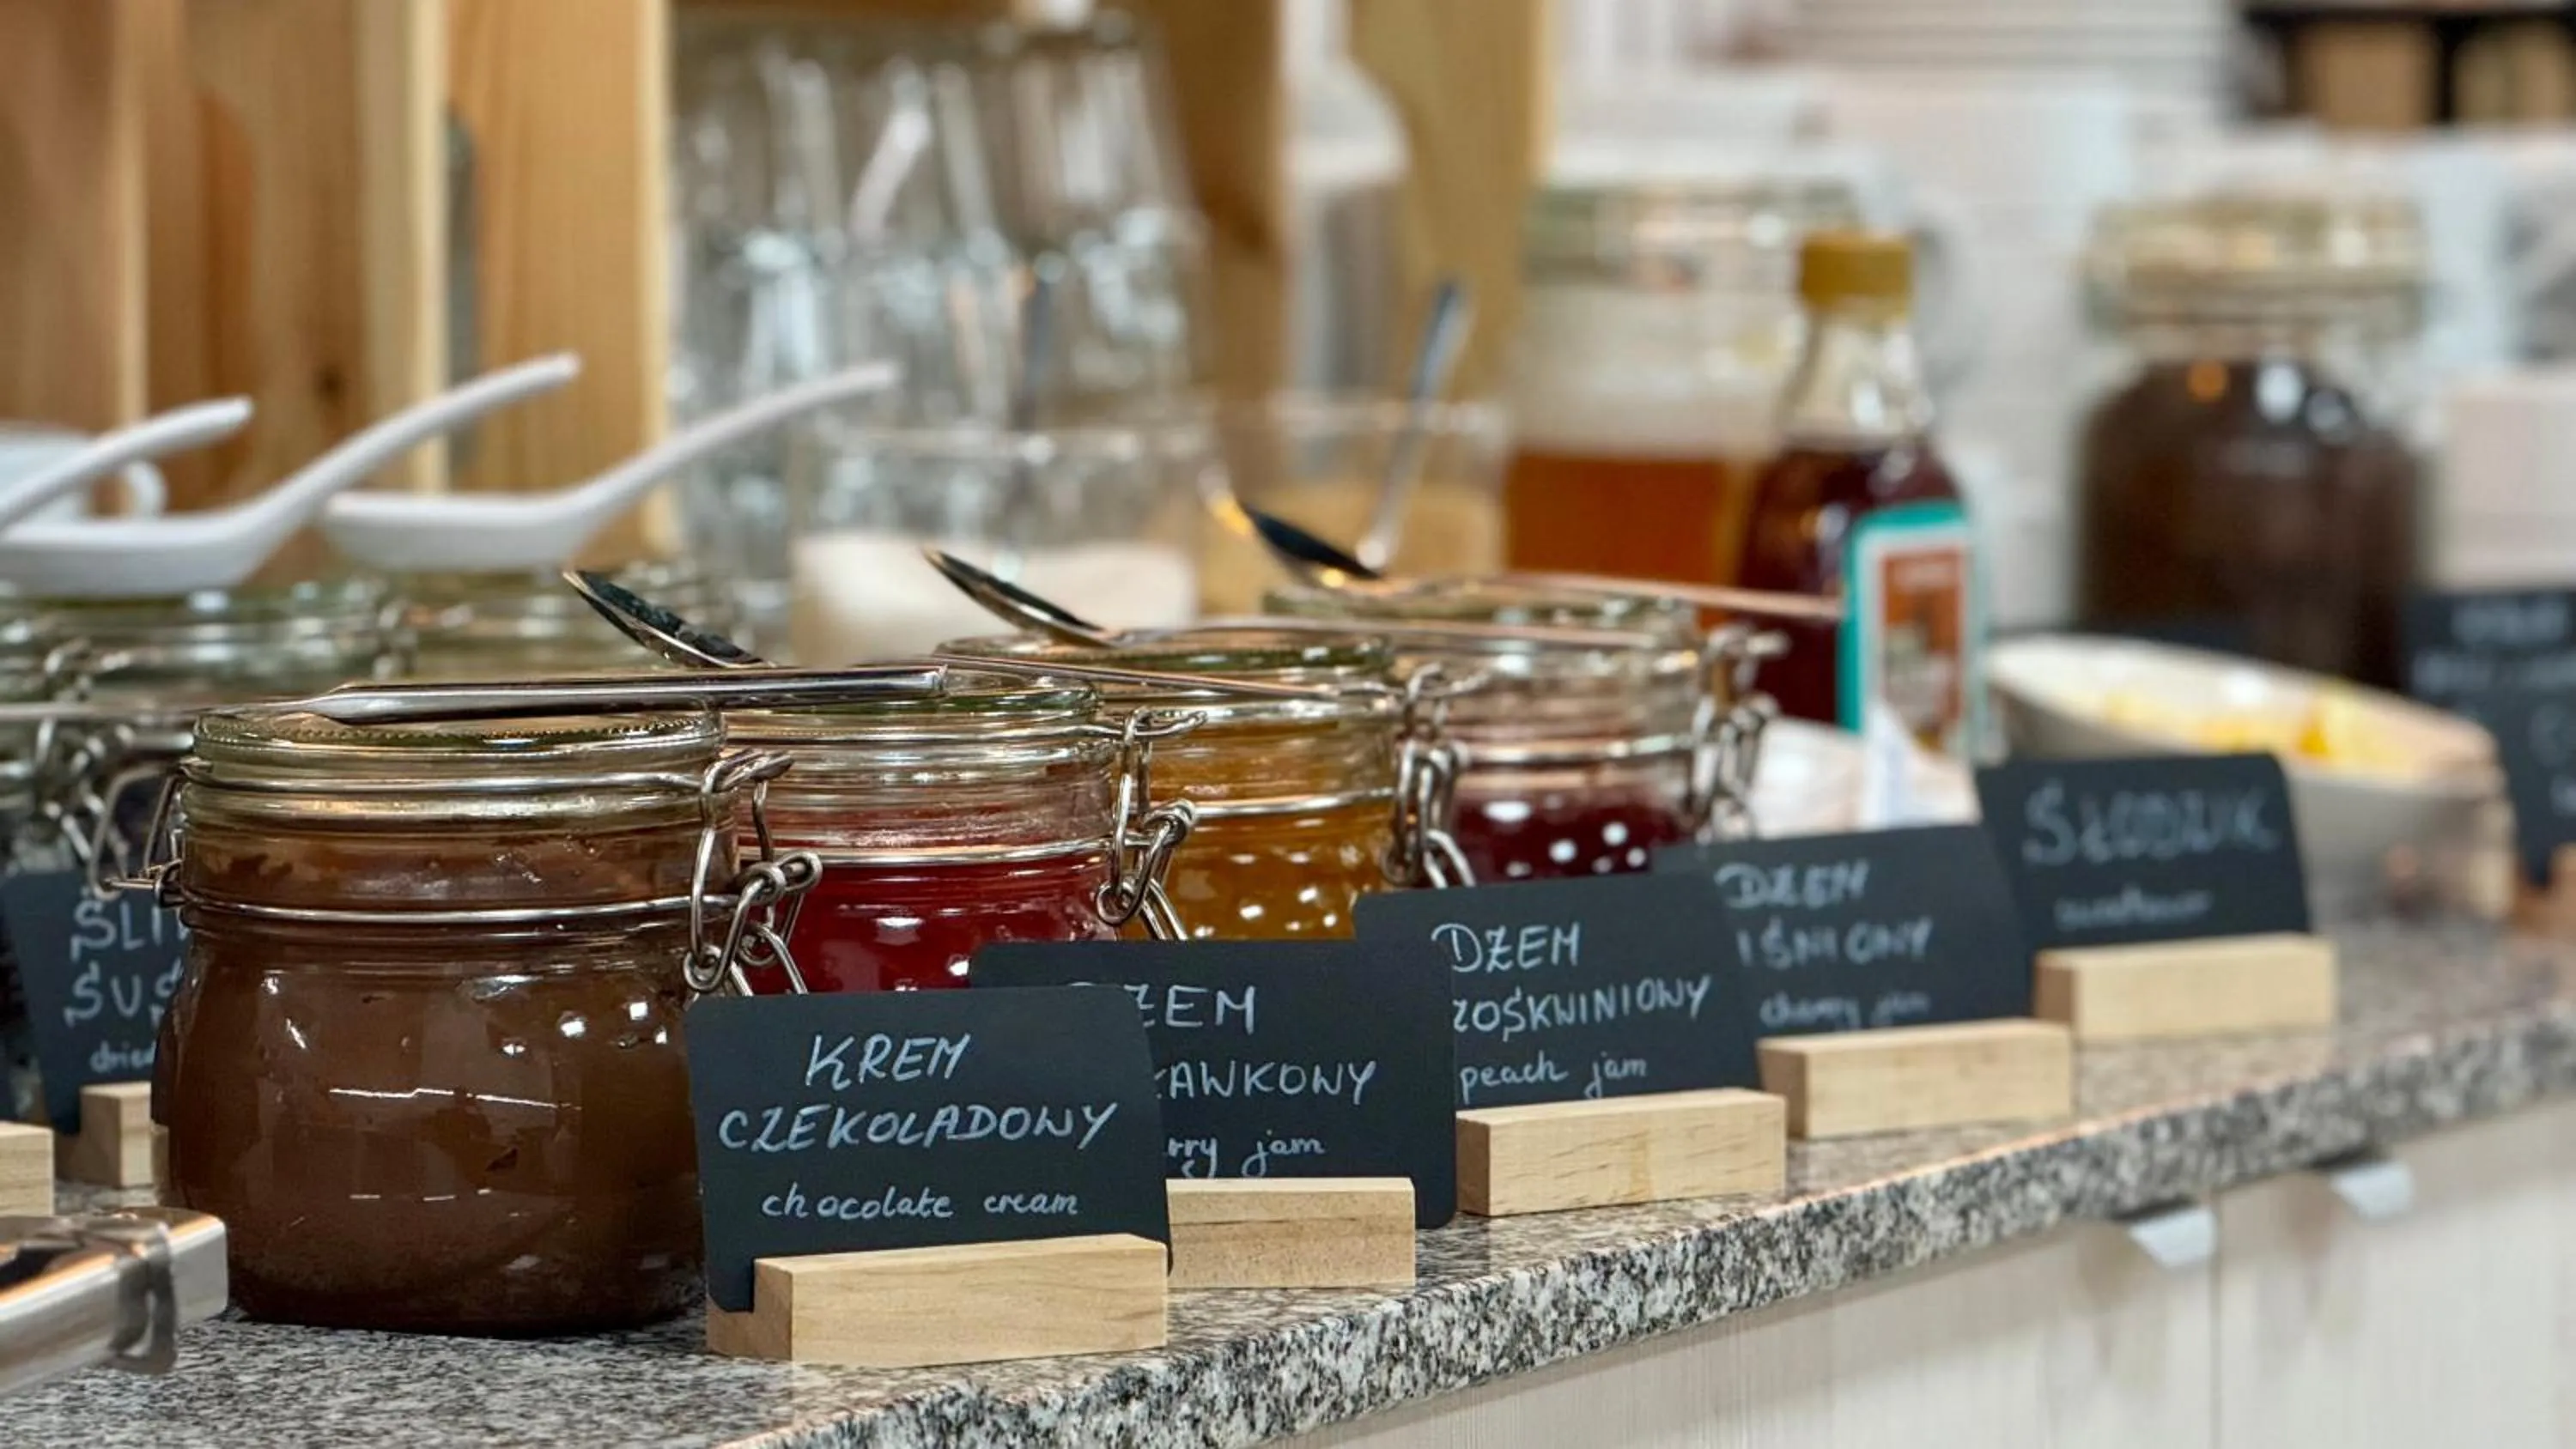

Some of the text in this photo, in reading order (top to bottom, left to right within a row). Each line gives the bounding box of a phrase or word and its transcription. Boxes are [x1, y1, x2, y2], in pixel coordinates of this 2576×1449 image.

[805, 1033, 970, 1091] KREM
[1154, 1059, 1376, 1105] AWKOWY
[1460, 1049, 1648, 1105] peach jam
[718, 1102, 1118, 1152] CZEKOLADOWY
[1242, 1129, 1327, 1177] jam
[762, 1182, 1078, 1221] chocolate cream
